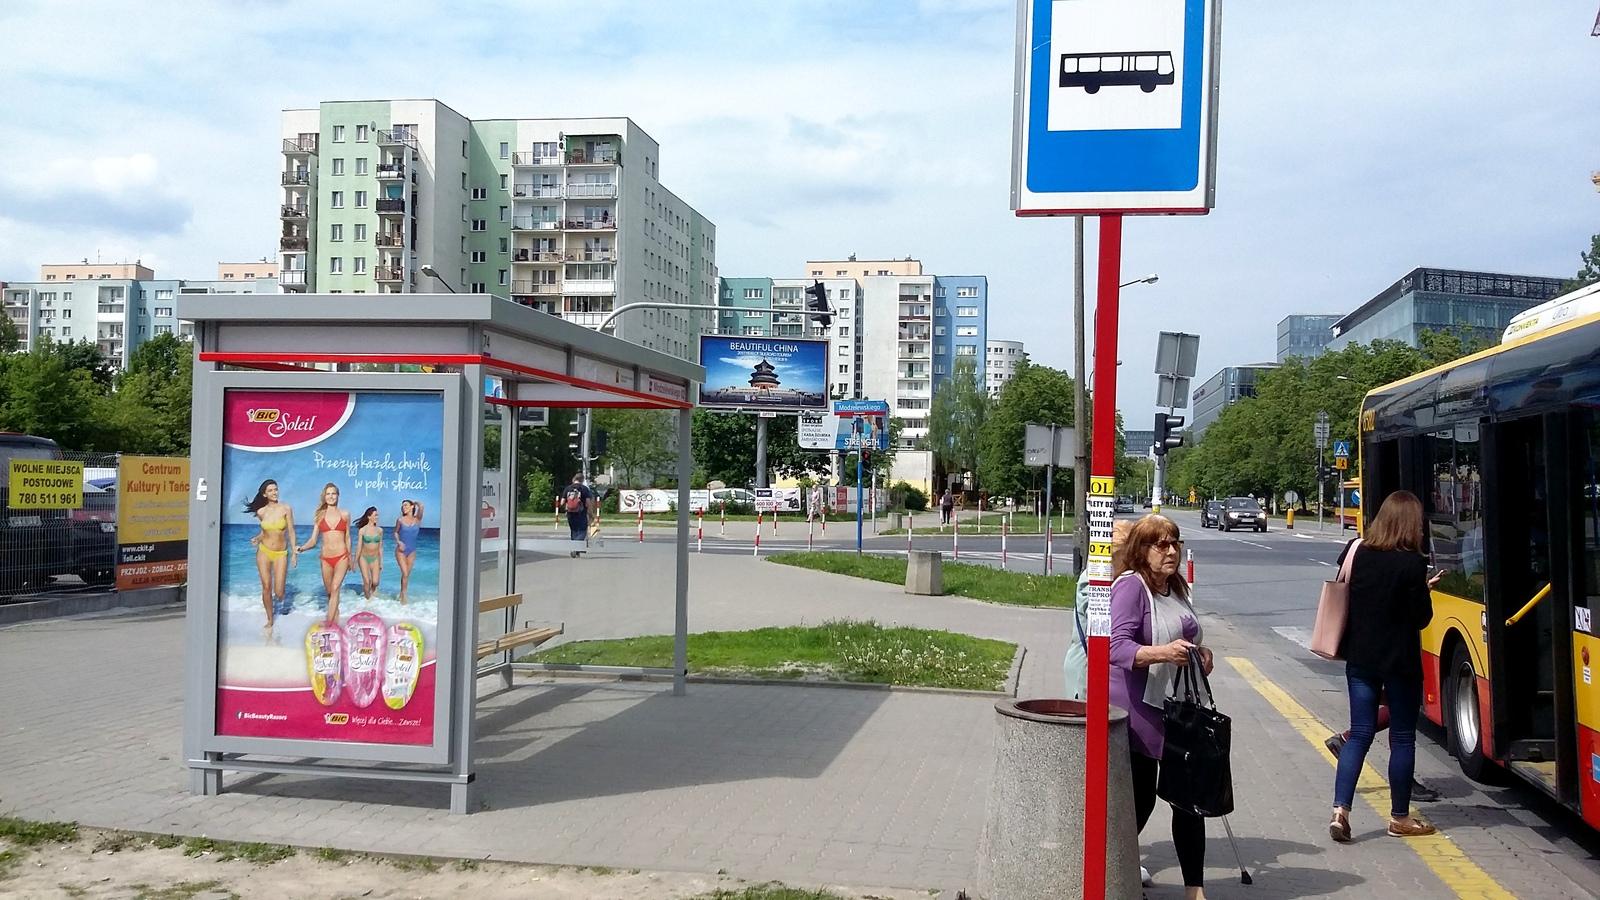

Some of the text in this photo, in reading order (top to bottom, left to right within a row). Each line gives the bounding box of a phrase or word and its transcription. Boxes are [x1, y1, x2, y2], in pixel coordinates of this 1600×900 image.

[730, 342, 799, 353] BEAUTIFUL CHINA
[256, 411, 317, 437] BIC Soleil
[142, 462, 181, 475] Centrum
[313, 450, 432, 477] Przeżyj każdą chwilę
[13, 464, 80, 475] WOLNE MIEJSCA
[23, 478, 74, 488] POSTOJOWE
[127, 480, 160, 495] Kultury
[354, 471, 428, 496] w pełni słońca!
[1091, 481, 1113, 493] OL
[19, 493, 77, 504] 780 511 961
[122, 544, 155, 552] www.ckit.pl
[1099, 545, 1111, 553] 71
[151, 564, 174, 574] ZOBACZ
[244, 712, 287, 721] BicBeautyRazors
